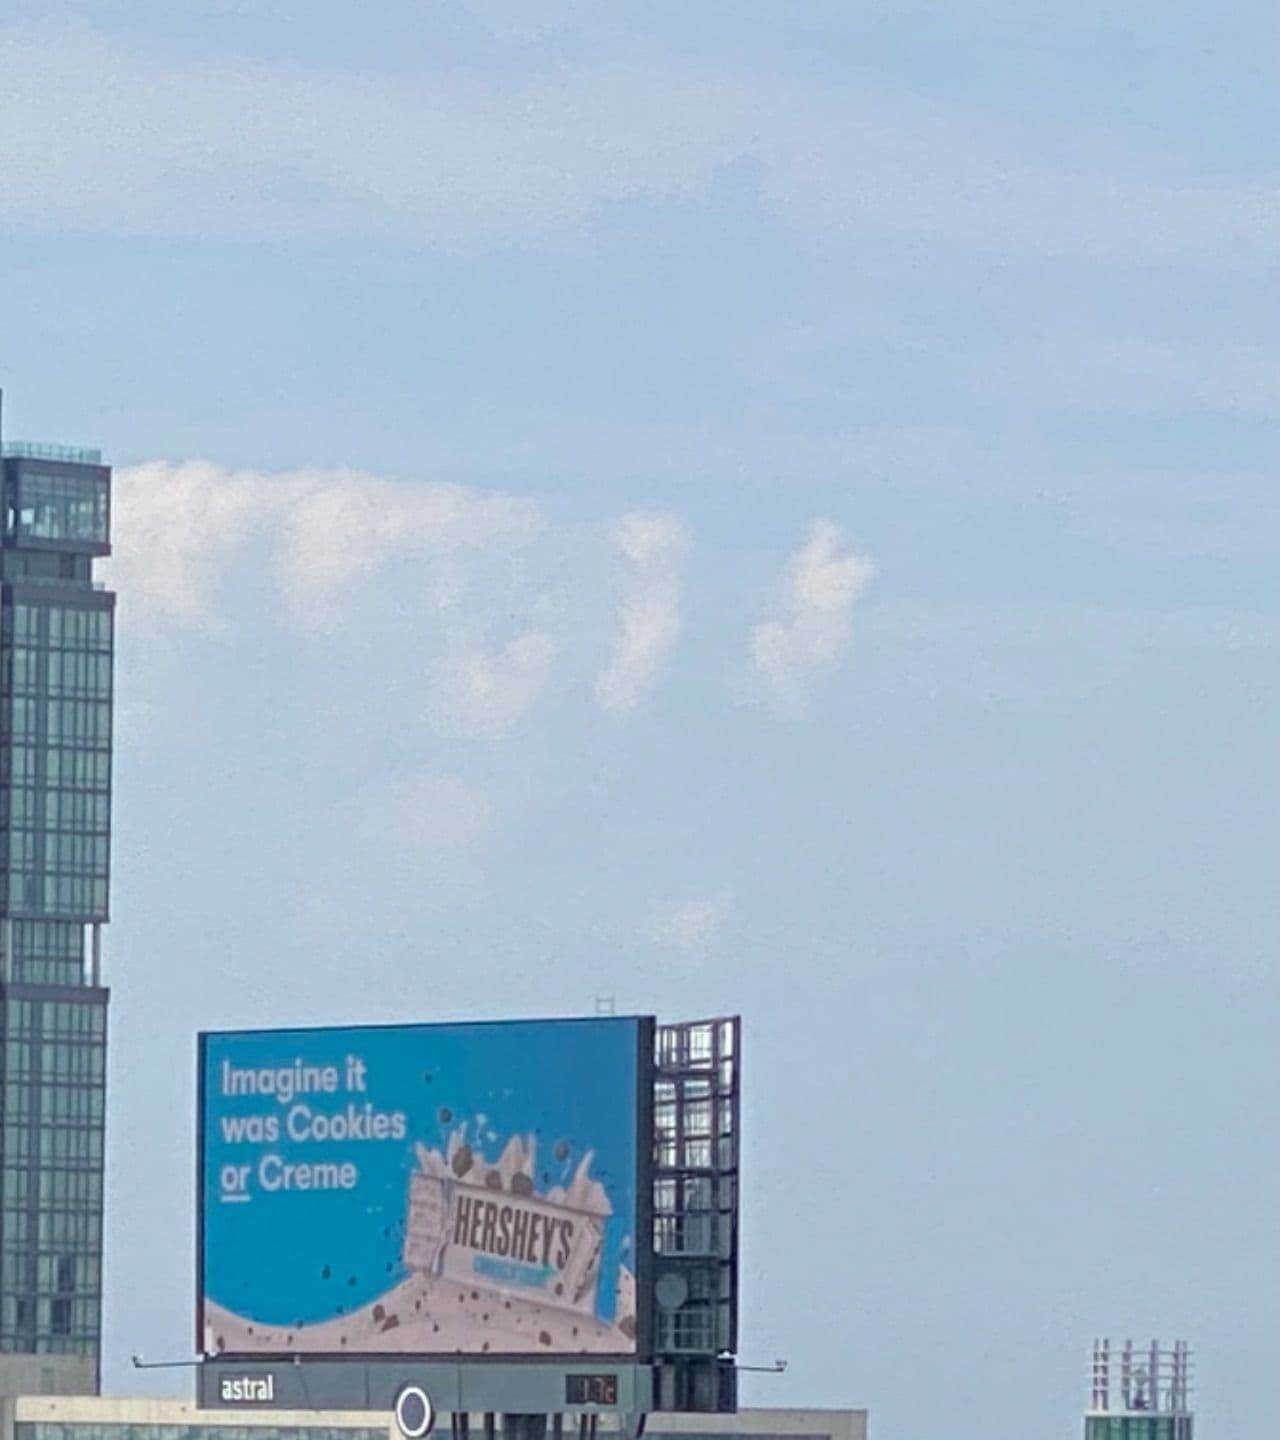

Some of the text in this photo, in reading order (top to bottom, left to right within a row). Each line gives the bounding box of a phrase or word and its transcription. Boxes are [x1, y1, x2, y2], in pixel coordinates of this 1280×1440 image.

[222, 1054, 367, 1104] Imagine it
[221, 1103, 406, 1143] was Cookies
[220, 1154, 357, 1192] or Creme
[453, 1195, 574, 1271] HERSHEY'S
[222, 1374, 273, 1400] astral
